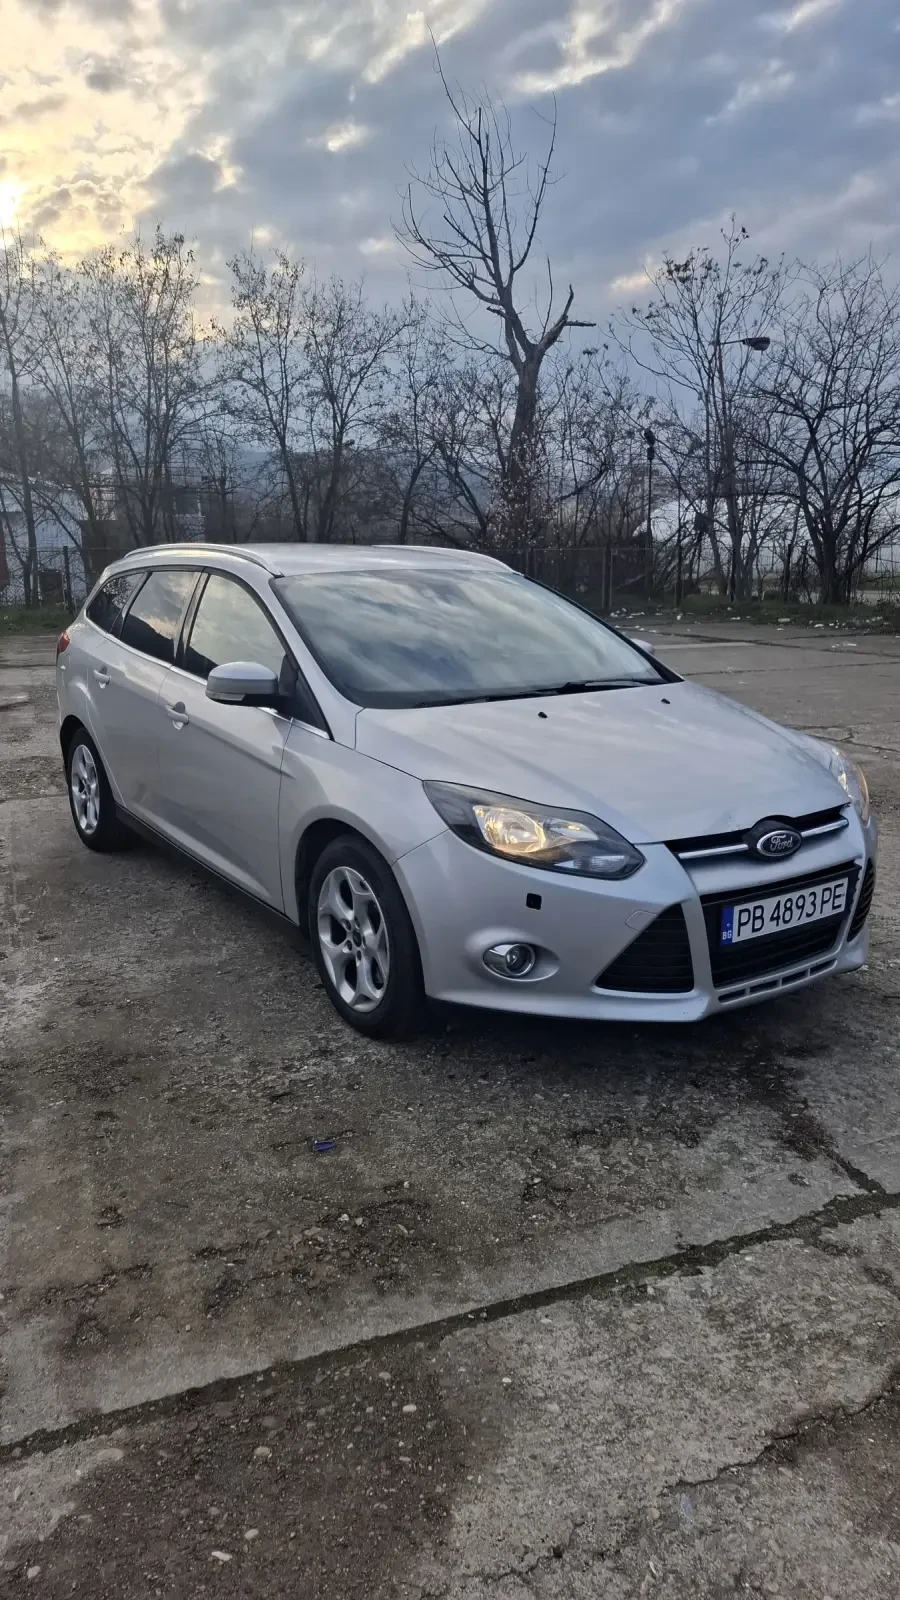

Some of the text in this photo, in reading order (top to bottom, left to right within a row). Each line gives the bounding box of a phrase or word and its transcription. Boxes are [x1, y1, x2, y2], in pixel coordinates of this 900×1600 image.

[769, 834, 793, 852] Ford
[737, 883, 845, 937] PB 4893 PE
[722, 931, 732, 940] BG
